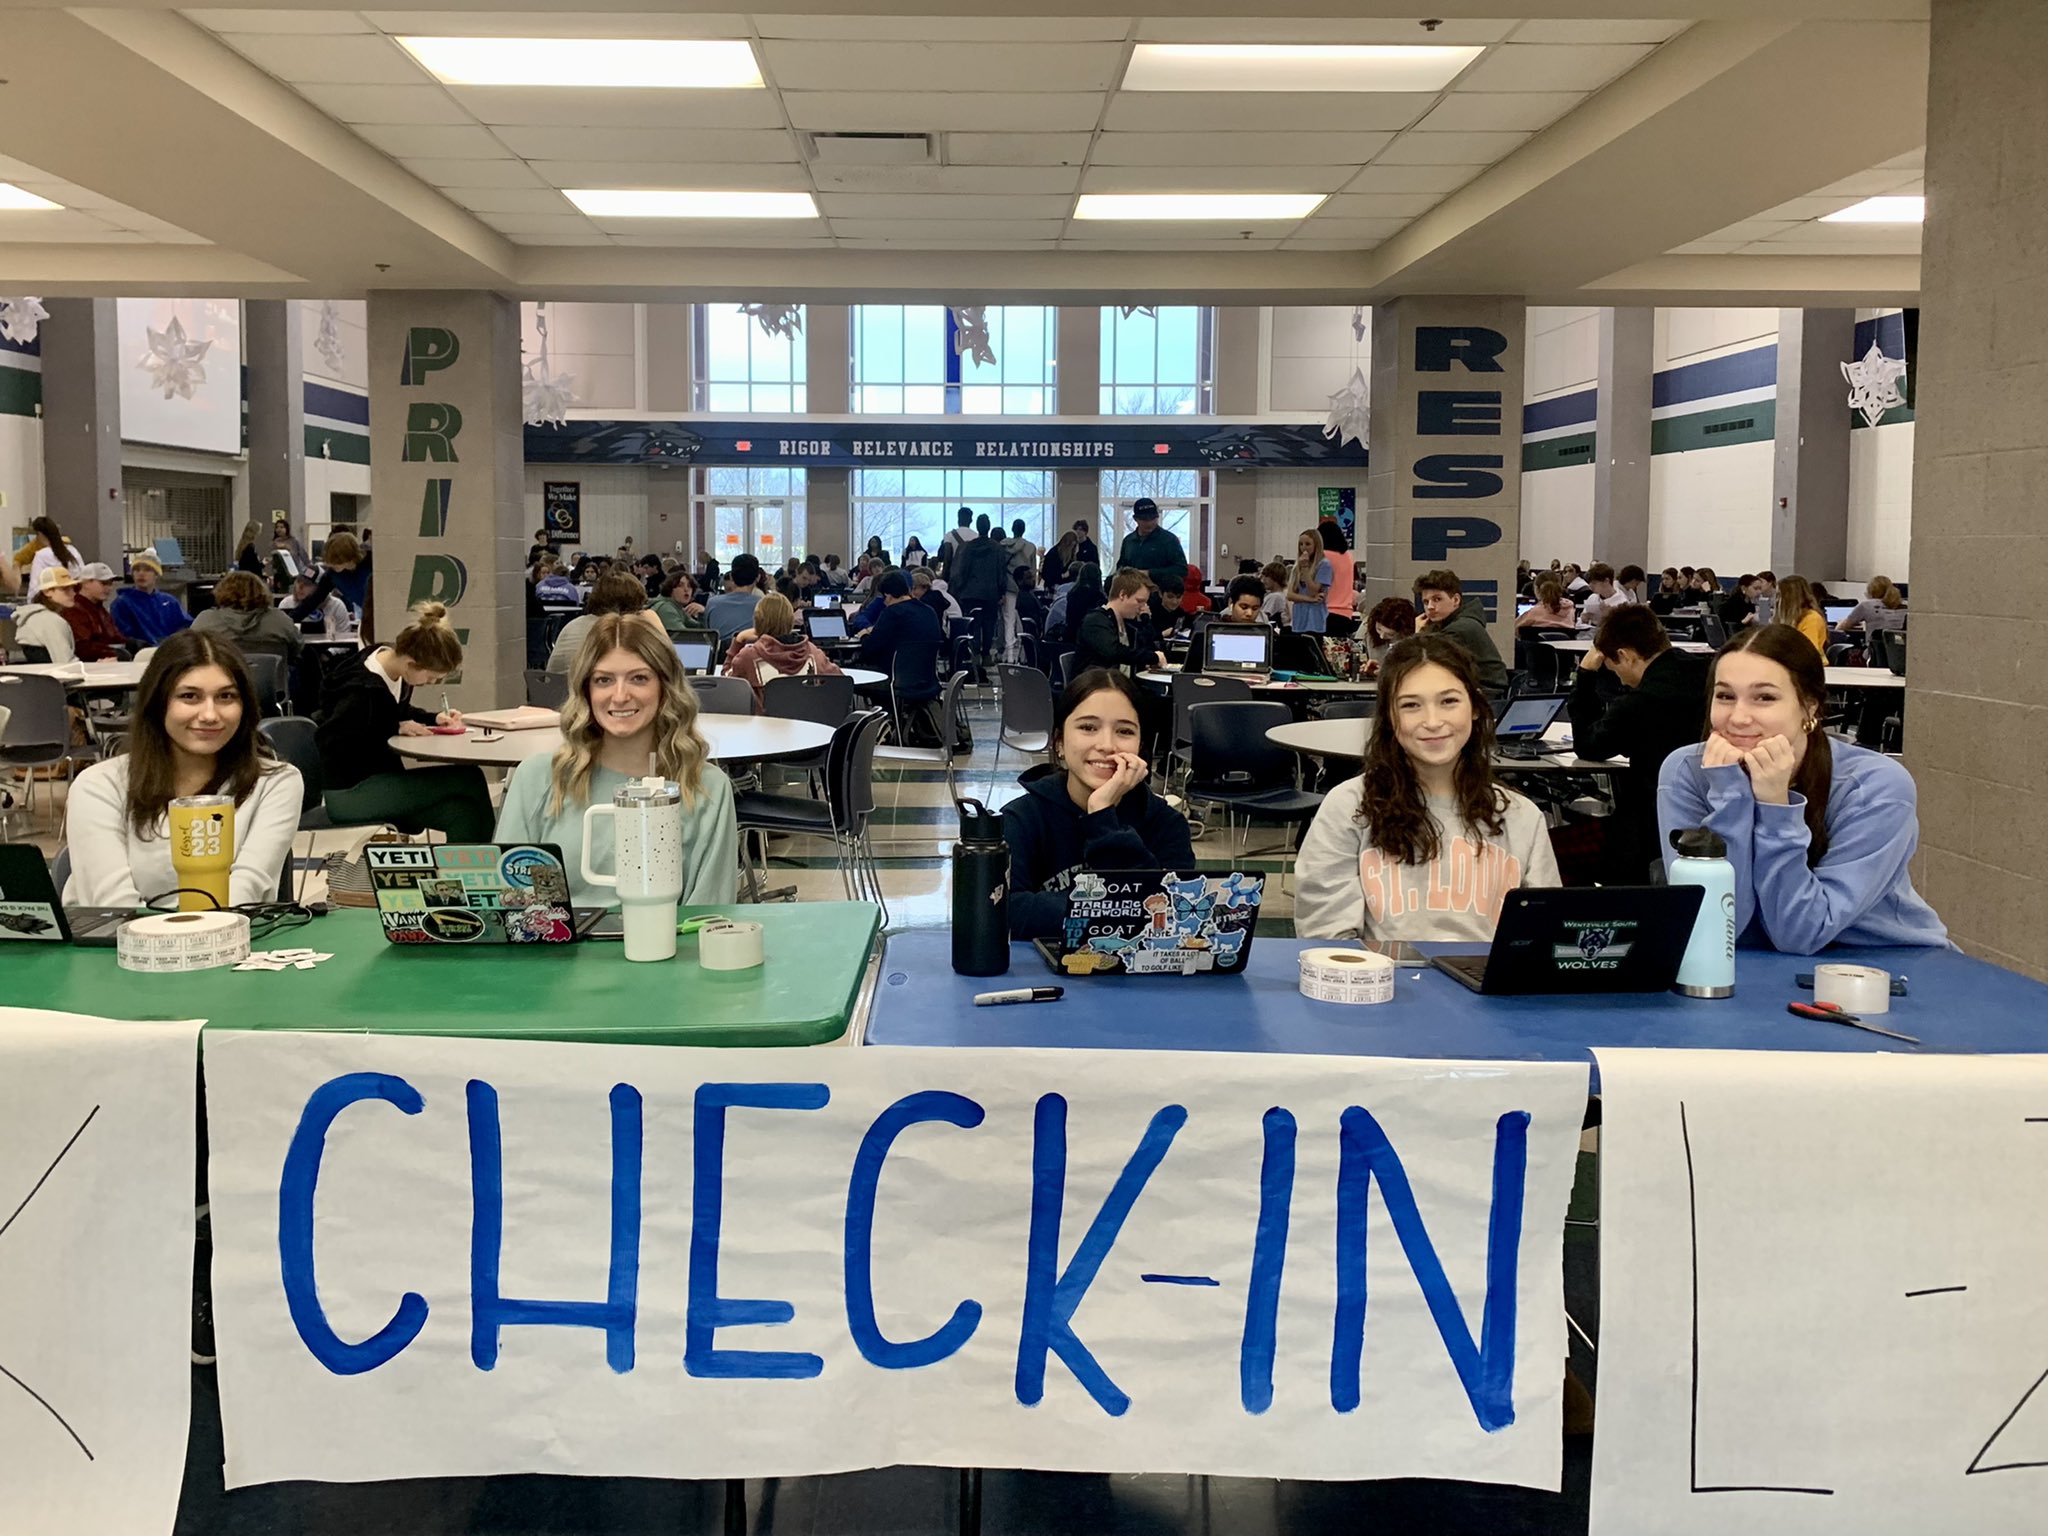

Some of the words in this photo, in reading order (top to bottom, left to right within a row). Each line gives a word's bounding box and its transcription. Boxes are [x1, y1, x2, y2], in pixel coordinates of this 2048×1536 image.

[779, 440, 831, 456] RIGOR
[852, 440, 954, 457] RELEVANCE
[975, 441, 1115, 457] RELATIONSHIPS
[559, 493, 577, 501] Make
[191, 837, 220, 857] 23
[371, 851, 428, 864] YETI
[441, 850, 497, 864] YETI
[1107, 883, 1143, 893] OAT
[1073, 900, 1142, 909] FARTING
[1070, 908, 1142, 918] NETWORK
[1066, 928, 1083, 938] TO
[1088, 924, 1135, 936] GOAT
[1558, 960, 1619, 969] WOLVES
[279, 1071, 1532, 1433] CHECK-IN
